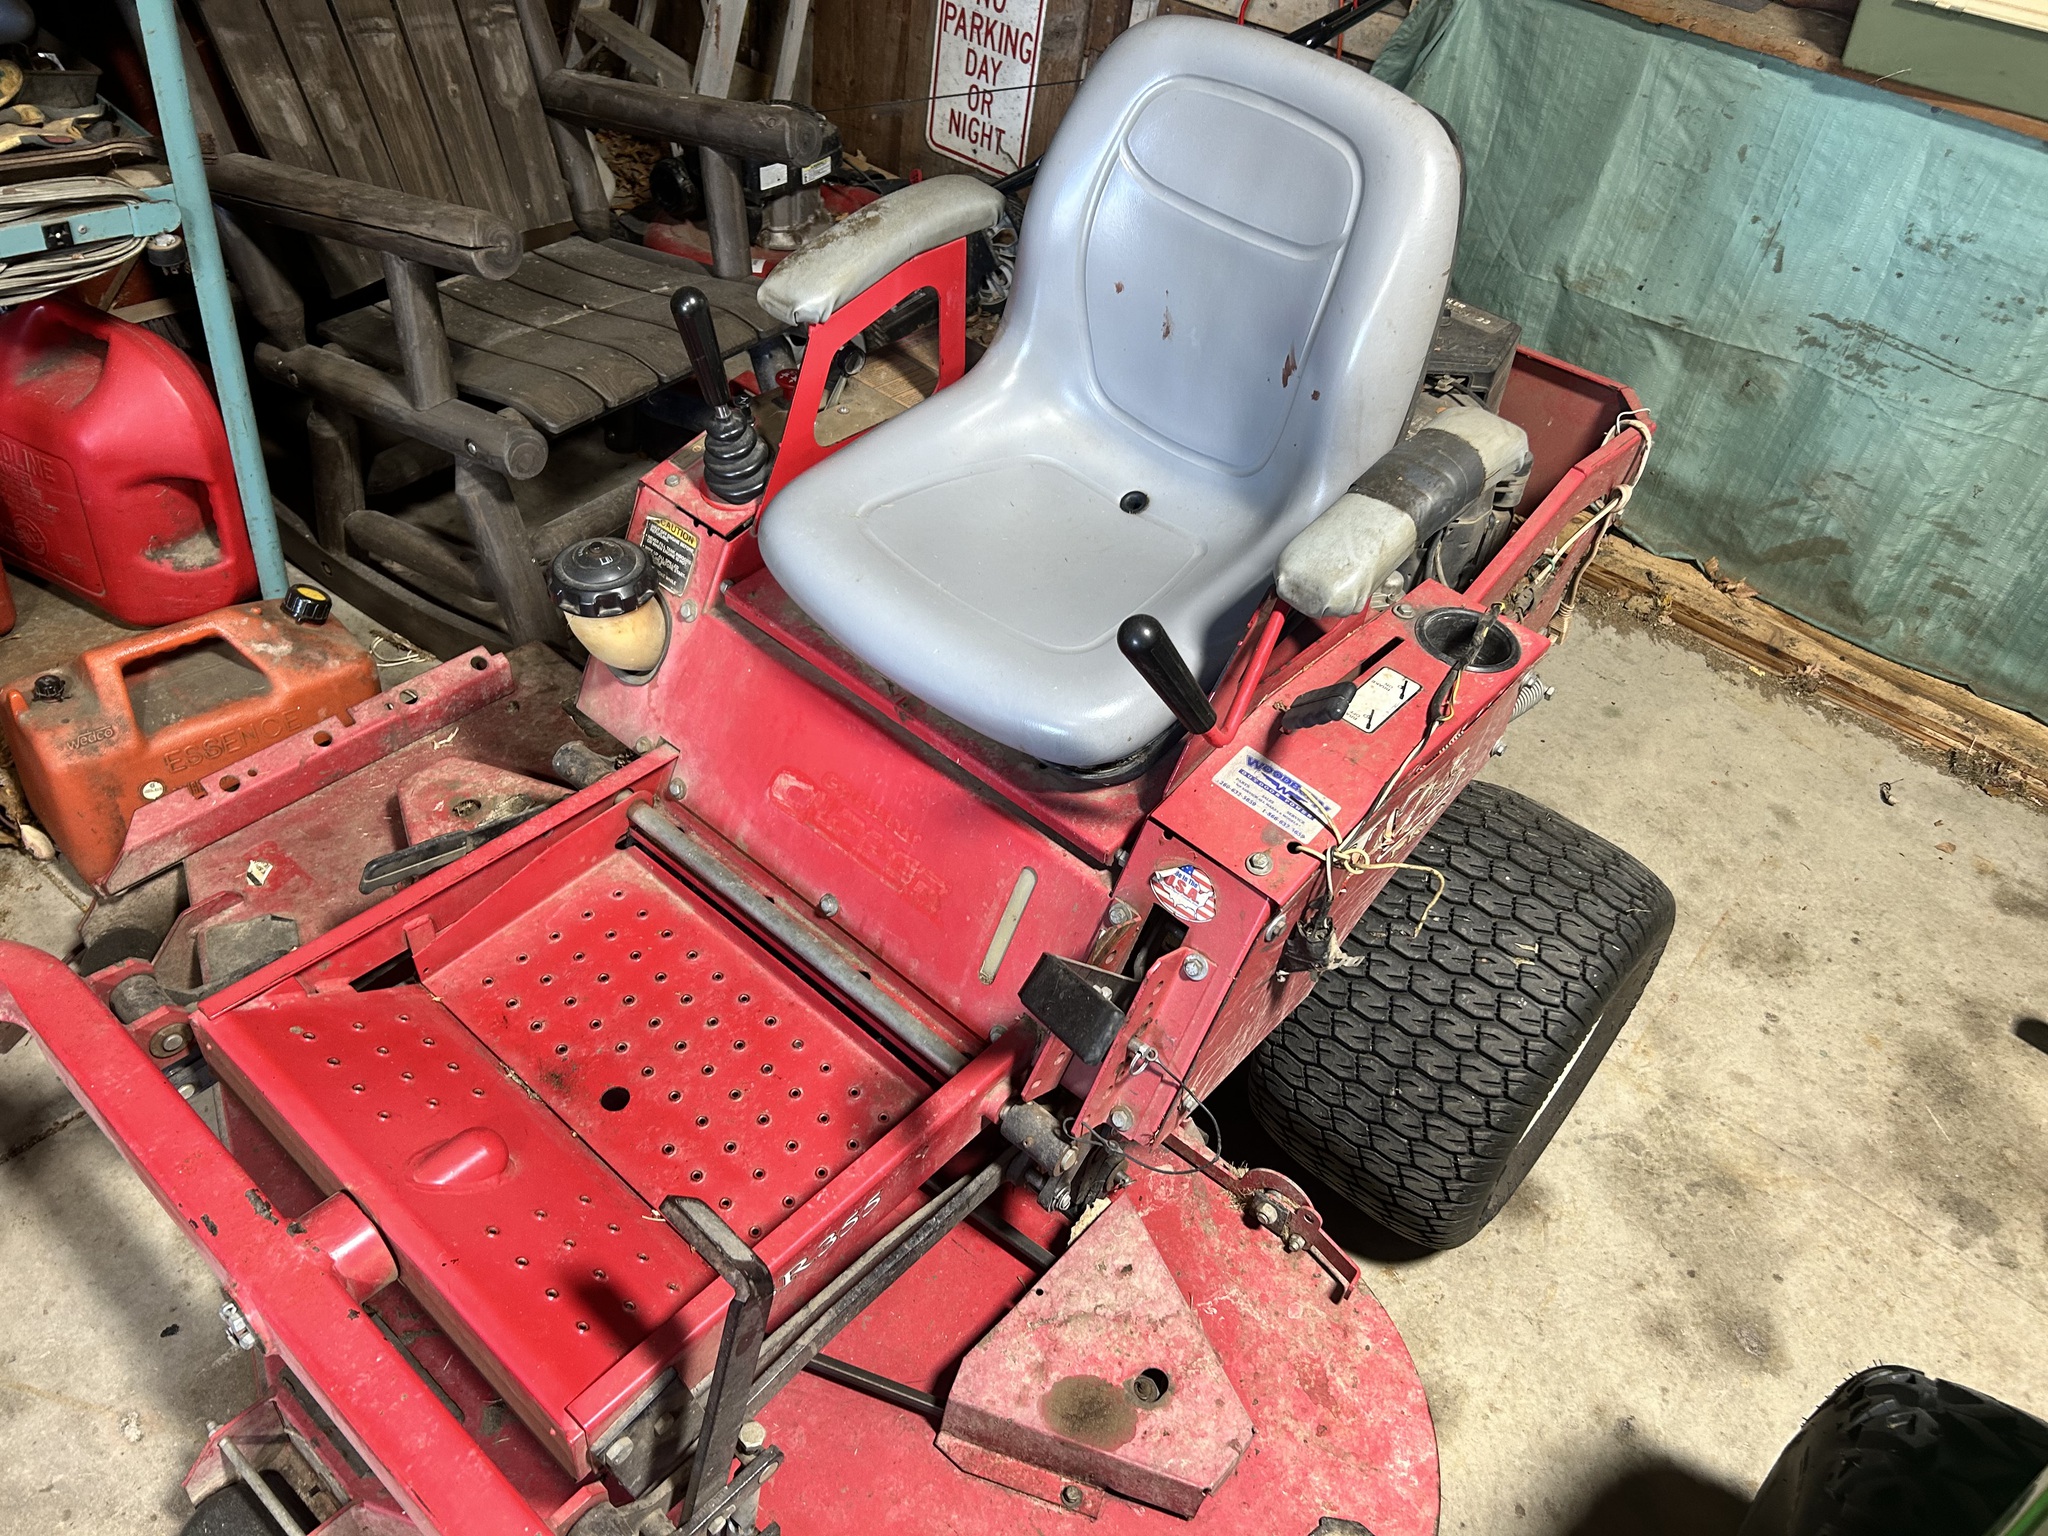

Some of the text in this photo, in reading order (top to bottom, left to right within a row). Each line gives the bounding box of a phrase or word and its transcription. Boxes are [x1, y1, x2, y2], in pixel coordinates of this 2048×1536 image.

[943, 1, 1034, 64] PARKING
[965, 47, 1003, 87] DAY
[967, 84, 994, 119] OR
[948, 107, 1006, 155] NIGHT
[660, 519, 695, 544] CAUTION
[163, 709, 302, 774] ESSENCE
[1240, 769, 1281, 798] OUTDOOR
[1247, 754, 1330, 812] WOODB
[1189, 879, 1199, 888] The
[774, 1189, 882, 1295] R355
